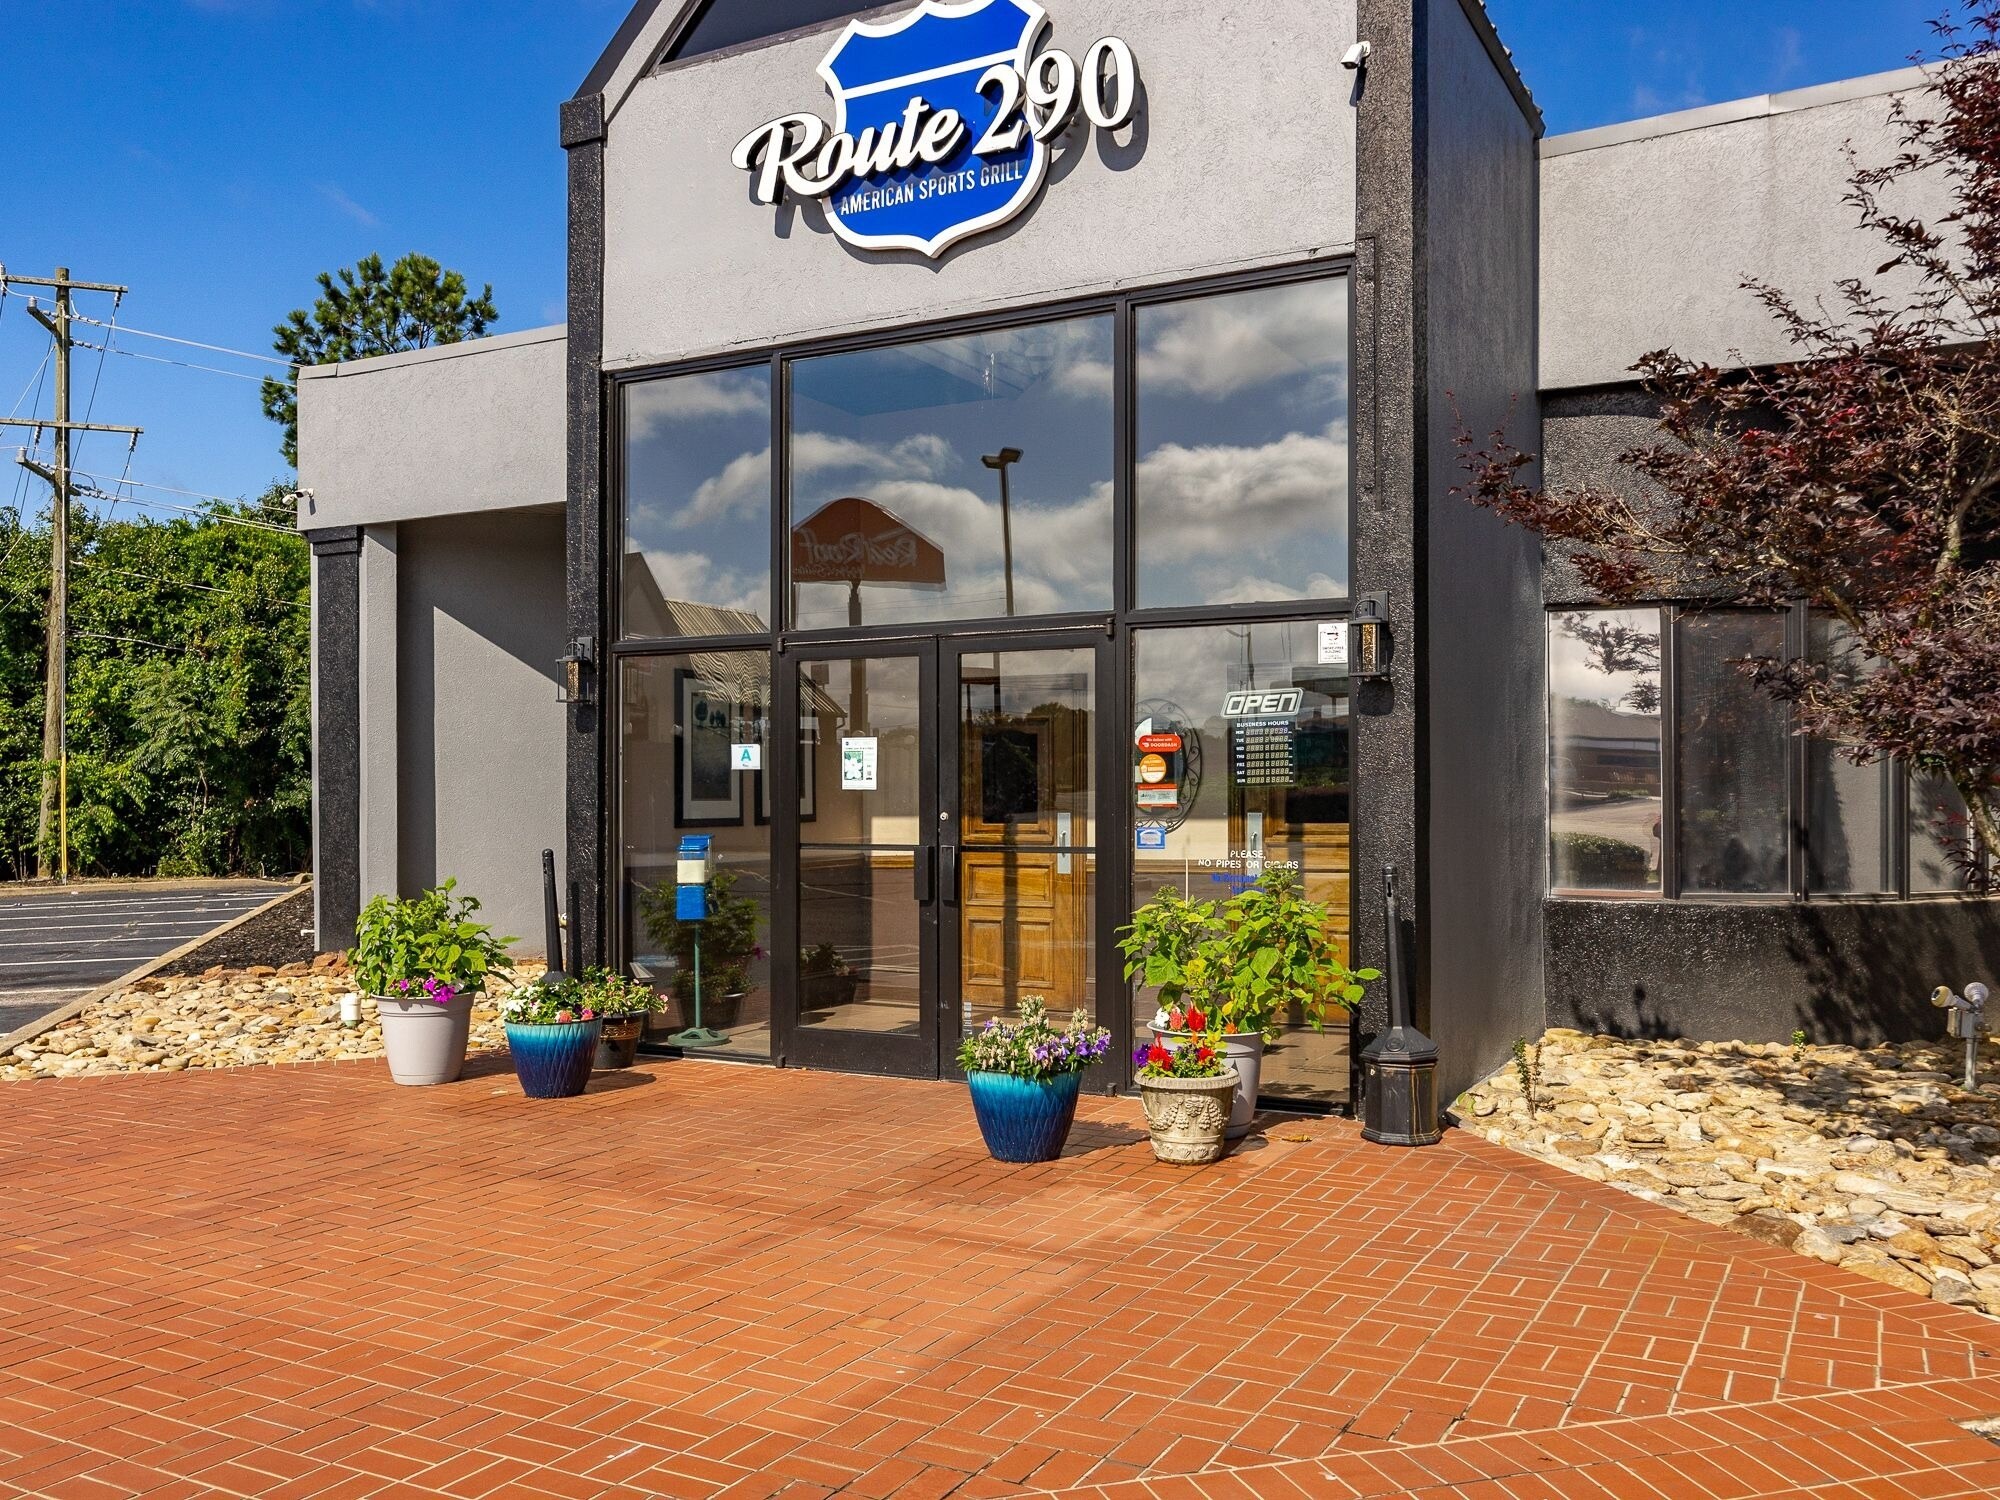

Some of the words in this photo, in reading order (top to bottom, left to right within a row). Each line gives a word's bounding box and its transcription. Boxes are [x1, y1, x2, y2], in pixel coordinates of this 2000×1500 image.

[731, 96, 966, 204] Route
[972, 35, 1136, 155] 290
[840, 183, 915, 215] AMERICAN
[919, 170, 975, 200] SPORTS
[980, 160, 1023, 187] GRILL
[1227, 693, 1298, 714] OPEN
[741, 749, 751, 761] A
[1230, 850, 1266, 860] PLEASE,
[1198, 859, 1211, 867] NO
[1215, 860, 1242, 869] PIPES
[1245, 860, 1260, 869] OR
